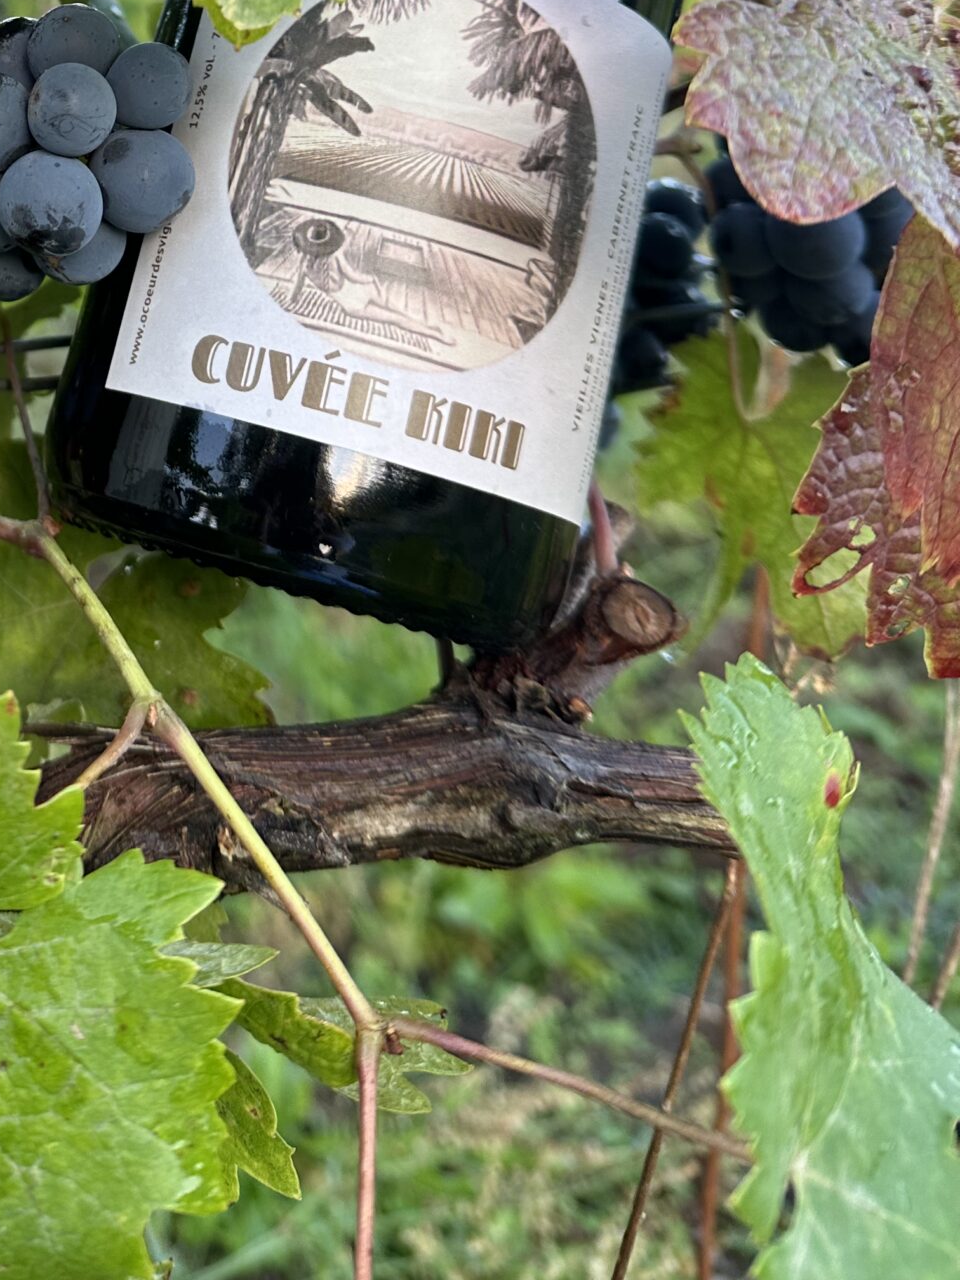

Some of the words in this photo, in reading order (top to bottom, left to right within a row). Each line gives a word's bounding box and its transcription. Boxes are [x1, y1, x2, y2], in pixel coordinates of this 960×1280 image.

[190, 84, 207, 129] 12,5%
[202, 53, 215, 82] vol.
[129, 220, 172, 365] www.ocoeurdesvig
[572, 352, 594, 433] VIEILLES
[589, 279, 608, 345] VIGNES
[608, 166, 630, 260] CABERNET
[626, 103, 644, 162] FRANC
[192, 334, 390, 428] CUVÉE
[404, 389, 526, 471] KIKI
